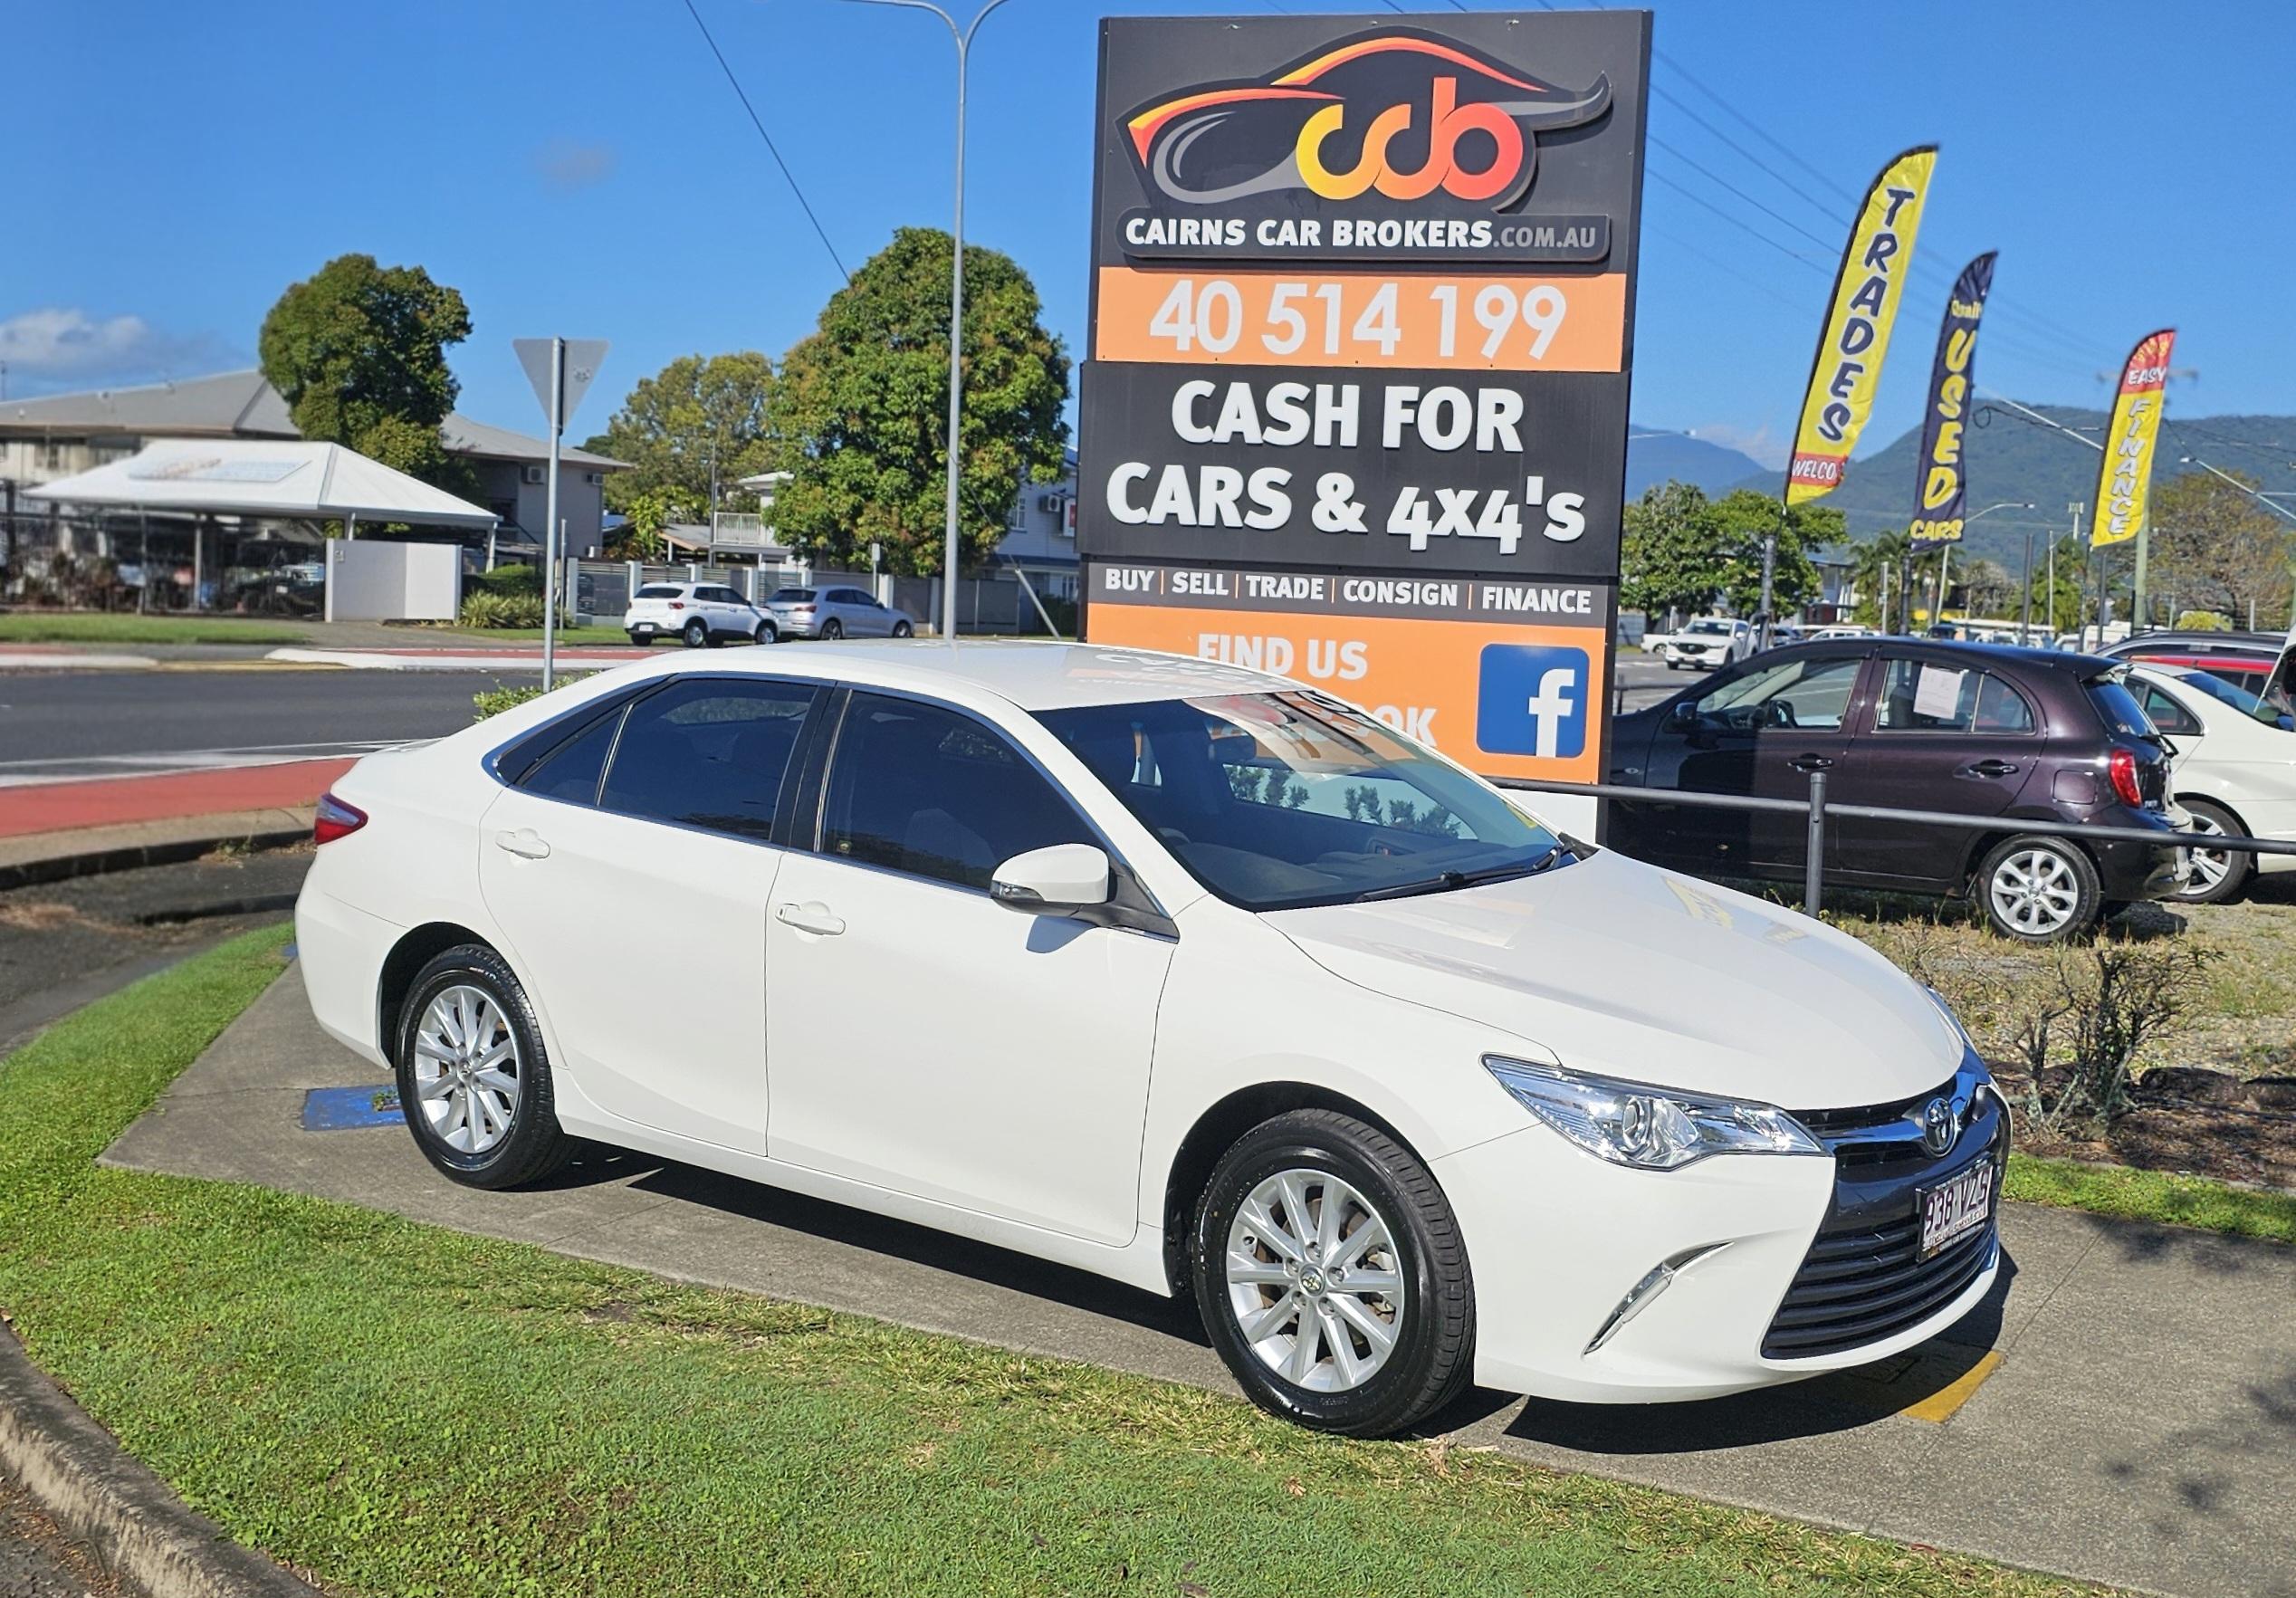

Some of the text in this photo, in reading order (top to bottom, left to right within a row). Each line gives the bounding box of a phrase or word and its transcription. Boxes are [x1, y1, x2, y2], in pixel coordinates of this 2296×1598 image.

[1125, 216, 1247, 247] CAIRNS
[1256, 218, 1322, 247] CAR
[1149, 279, 1567, 360] 40 514 199
[1817, 187, 1916, 443] TRADES
[2128, 367, 2167, 385] EASY
[1172, 379, 1524, 453] CASH FOR
[1923, 328, 1976, 511] USED
[1792, 459, 1838, 480] WELCO
[2108, 397, 2151, 535] FINANCE
[1106, 462, 1293, 531] CARS
[1311, 472, 1369, 533] &
[1909, 519, 1965, 541] CARS
[1105, 569, 1593, 615] BUY SELL TRADE CONSIGN FINANCE
[1197, 632, 1296, 676] FIND
[1306, 638, 1368, 681] US
